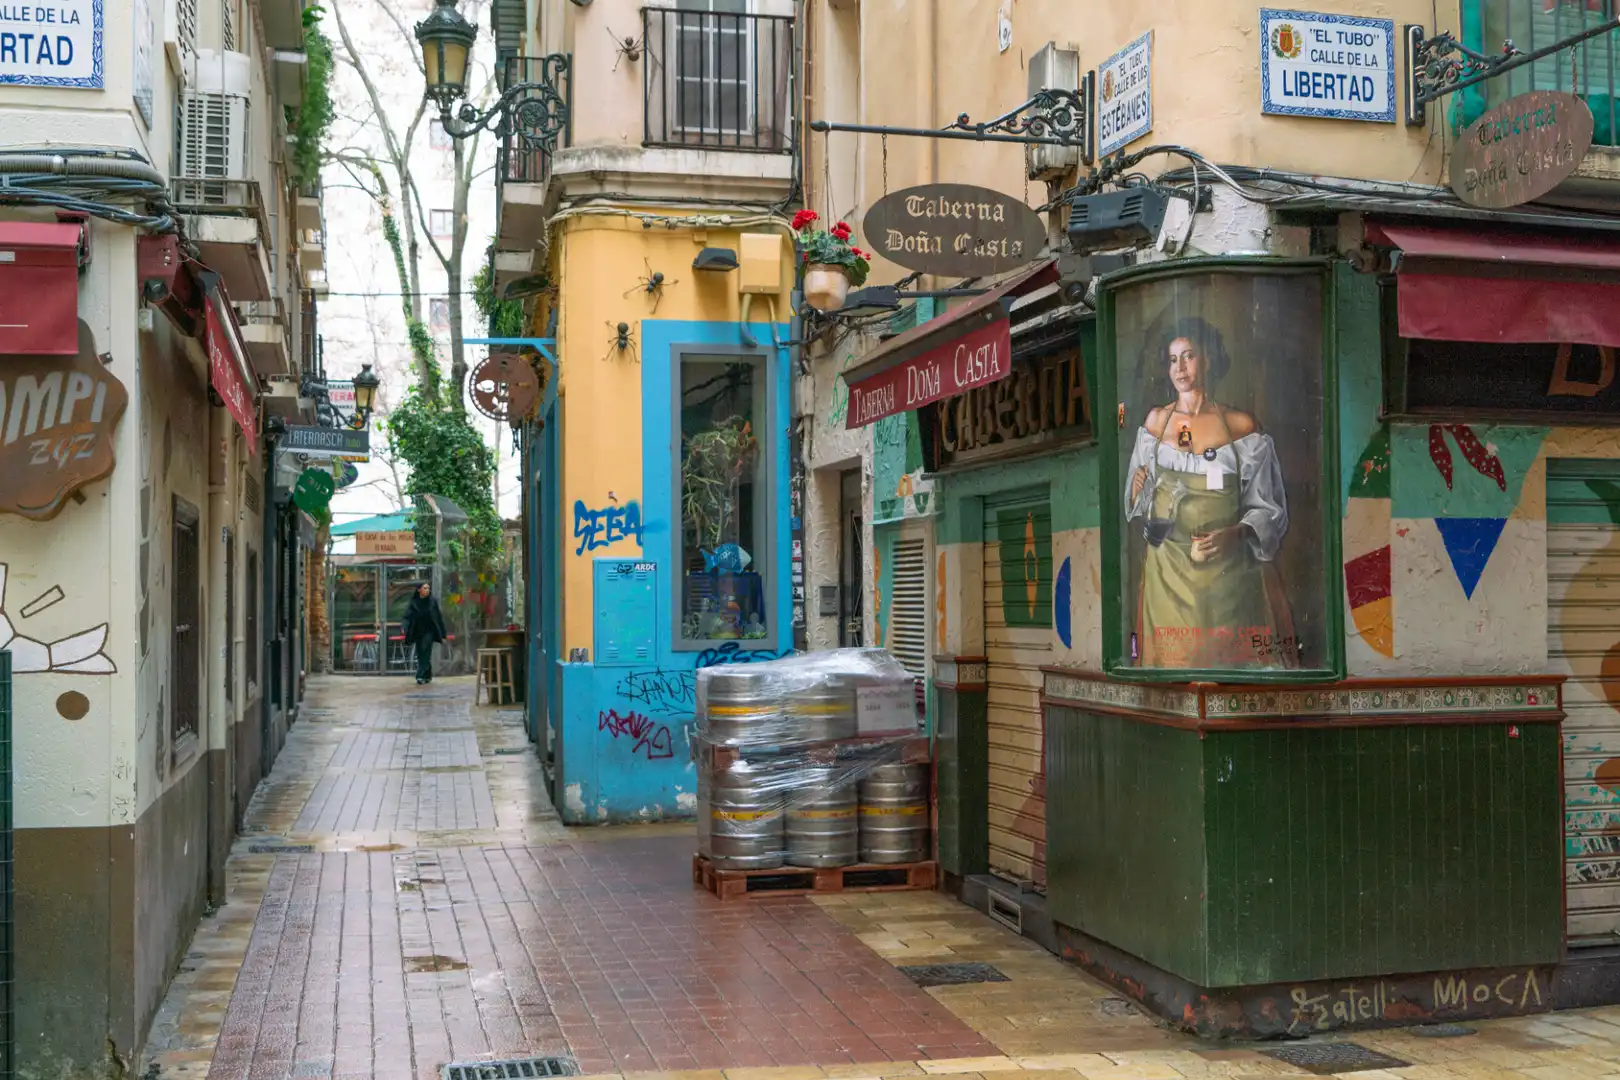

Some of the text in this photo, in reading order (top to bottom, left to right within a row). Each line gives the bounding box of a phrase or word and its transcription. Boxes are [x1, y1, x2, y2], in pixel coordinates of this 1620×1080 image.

[35, 7, 56, 23] DE
[60, 8, 80, 25] LA
[1310, 49, 1379, 68] CALLE DE LA
[1114, 64, 1148, 98] CALLE DE LOS
[1283, 69, 1374, 102] LIBERTAD
[1102, 90, 1147, 140] ESTÉBANES
[905, 195, 1005, 223] Taberna
[885, 228, 1024, 258] Doña Casta
[906, 360, 941, 405] DOÑA
[954, 341, 1001, 388] CASTA
[635, 563, 656, 571] ARDE
